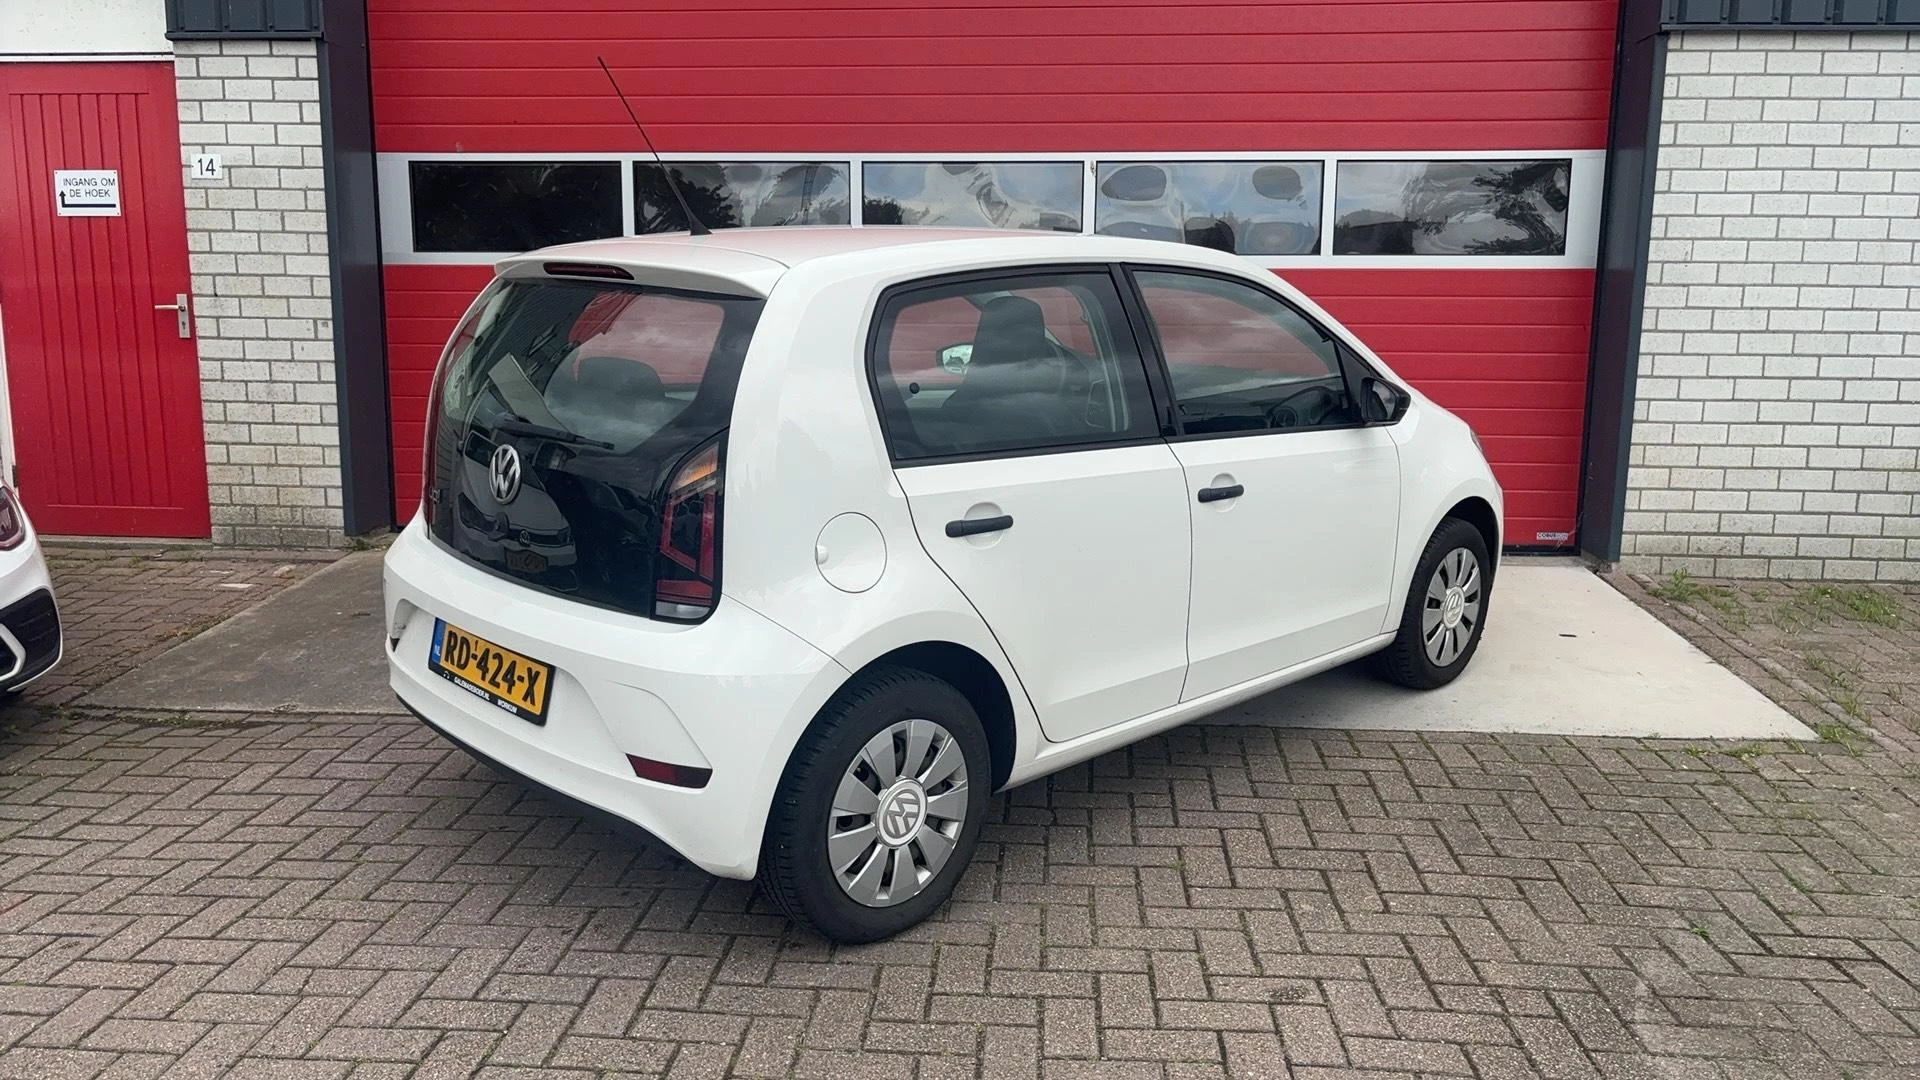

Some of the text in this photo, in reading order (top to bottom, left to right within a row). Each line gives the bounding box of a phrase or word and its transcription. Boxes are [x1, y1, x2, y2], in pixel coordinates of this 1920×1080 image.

[197, 158, 216, 176] 14
[63, 178, 116, 187] INGANG OM
[69, 188, 111, 198] DE HOEK
[444, 630, 541, 706] RD-424-X
